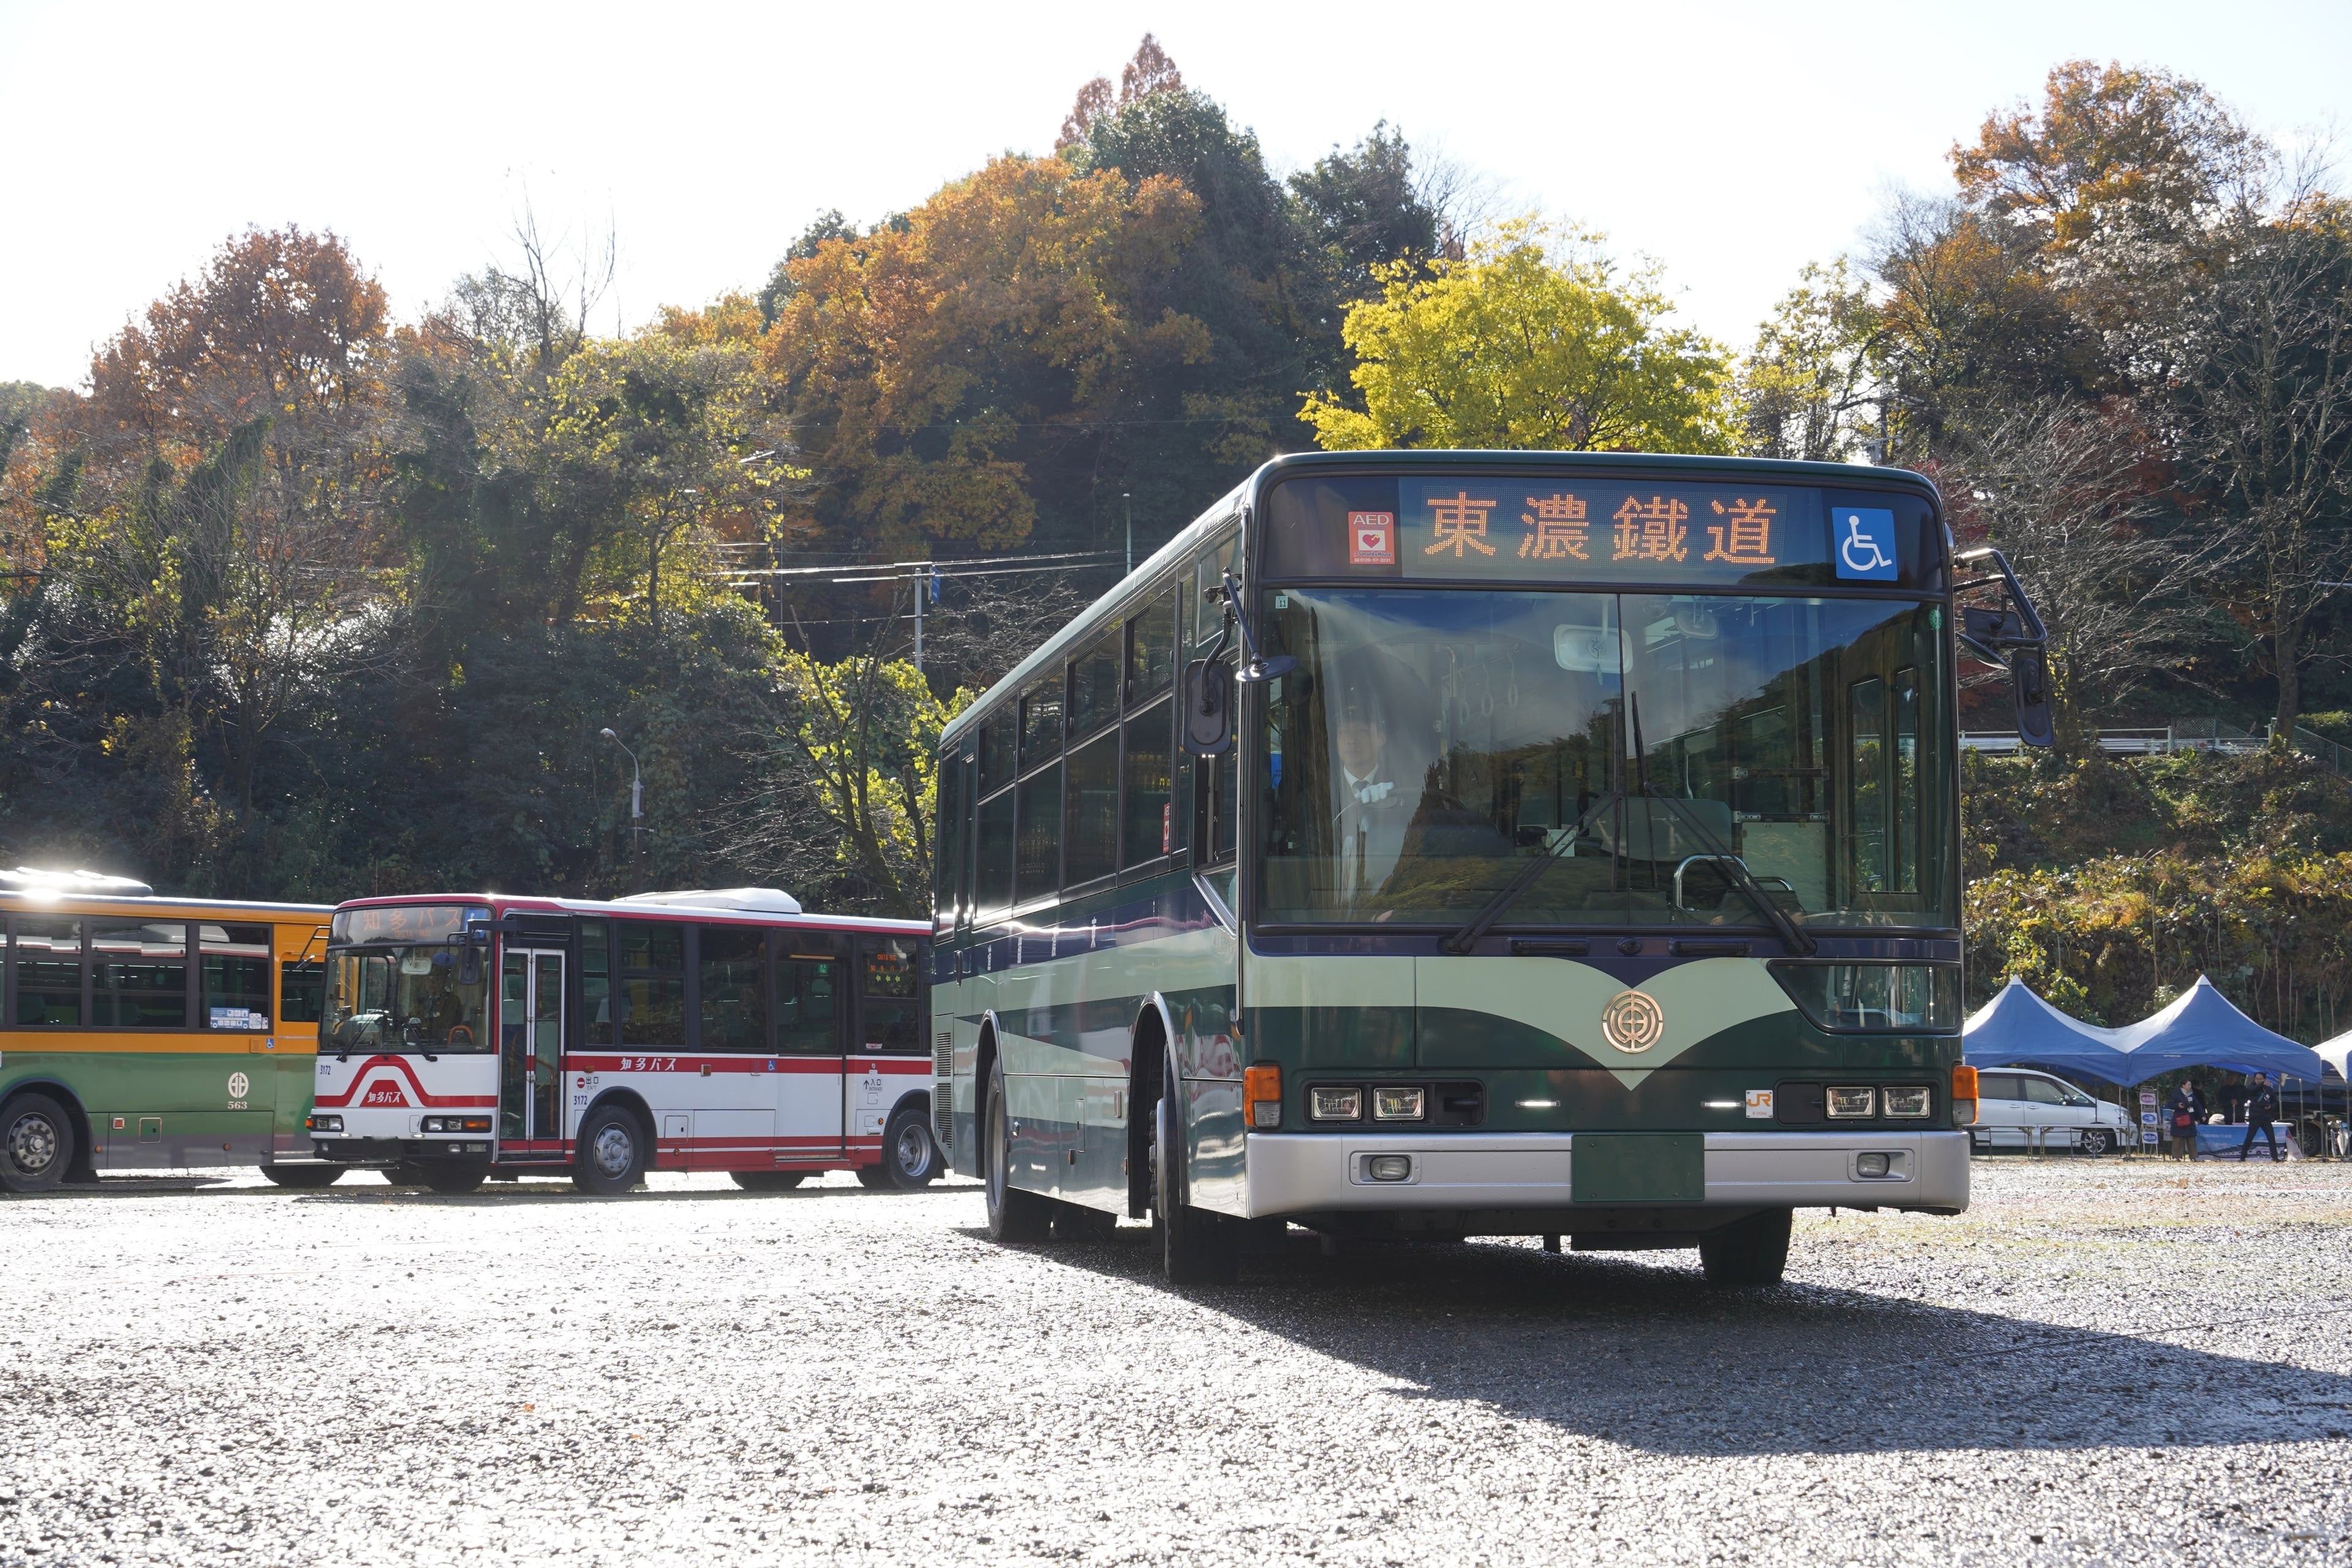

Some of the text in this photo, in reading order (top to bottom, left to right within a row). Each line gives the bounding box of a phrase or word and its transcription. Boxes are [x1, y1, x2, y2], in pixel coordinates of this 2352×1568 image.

[1353, 514, 1390, 525] AED
[1424, 491, 1776, 564] 東濃鐵道
[363, 908, 460, 932] 知多バス
[420, 929, 431, 937] BUS
[619, 1057, 677, 1071] 知多バス
[320, 1065, 331, 1075] 3172
[586, 1076, 599, 1085] 出口
[368, 1091, 402, 1103] 知多バス
[573, 1095, 587, 1106] 3172
[1747, 1093, 1771, 1107] JR
[227, 1101, 247, 1110] 563
